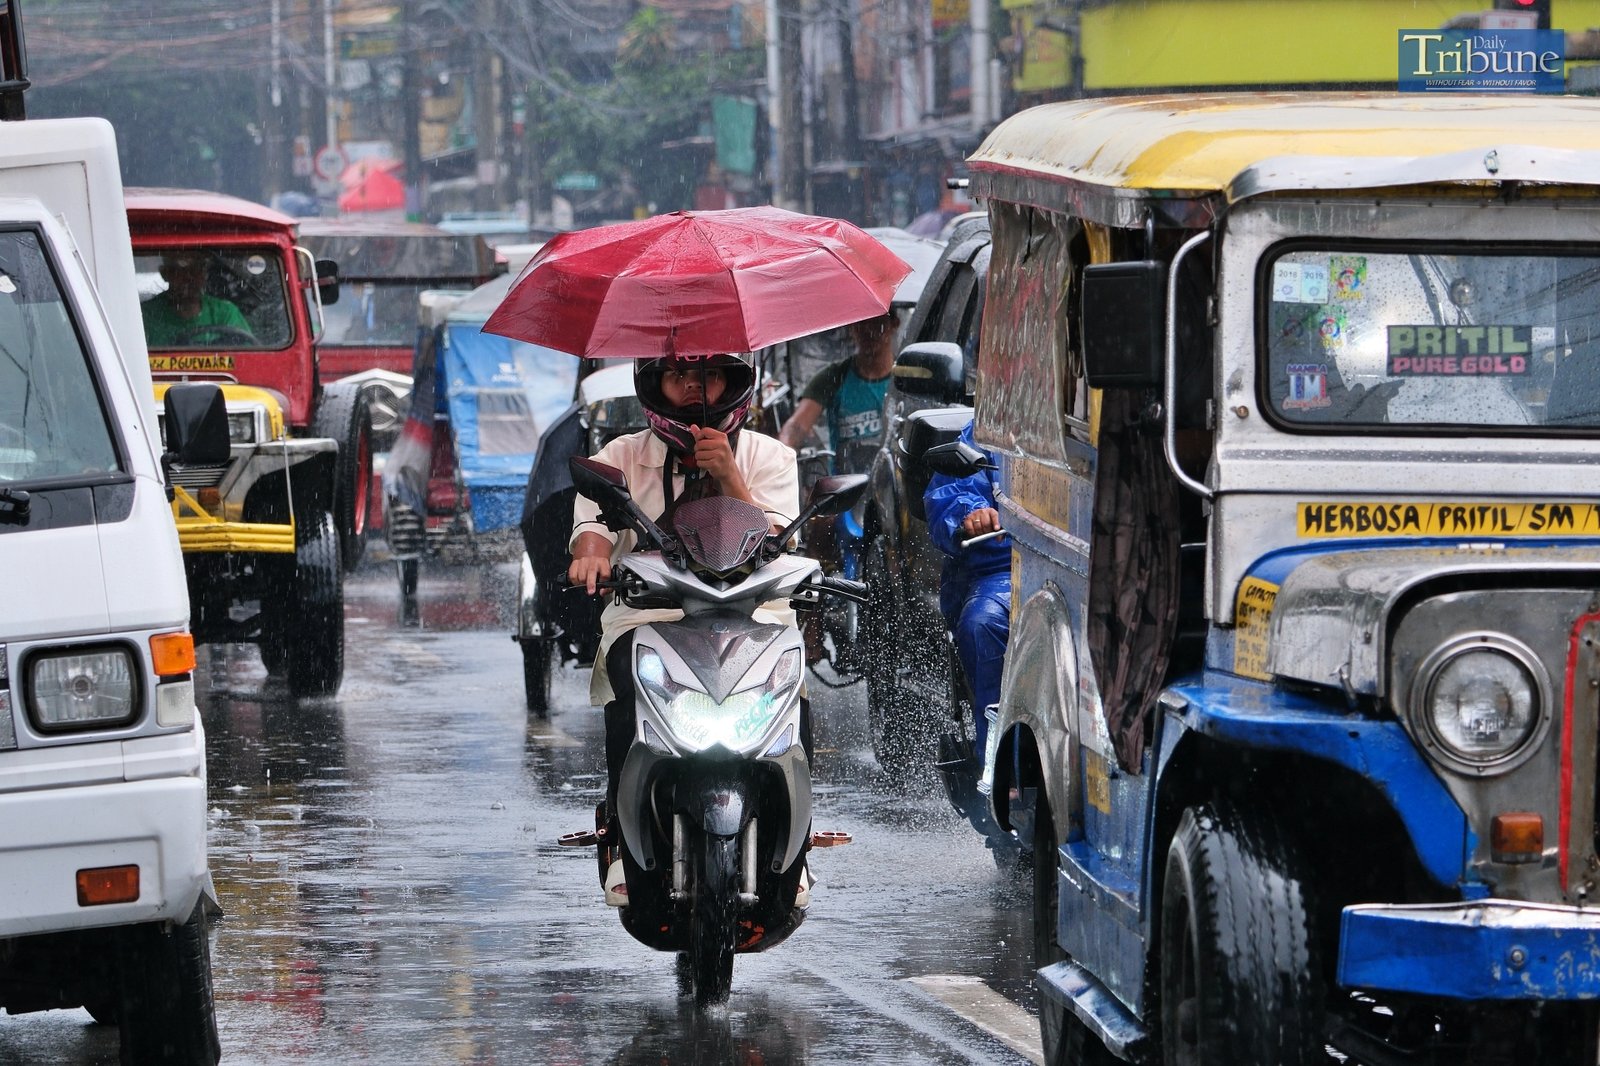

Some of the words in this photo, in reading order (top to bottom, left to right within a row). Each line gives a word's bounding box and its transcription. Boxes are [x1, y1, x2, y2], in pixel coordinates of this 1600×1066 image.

[1279, 269, 1298, 279] 2018
[1304, 271, 1324, 280] 2019
[1389, 326, 1529, 355] PRITIL
